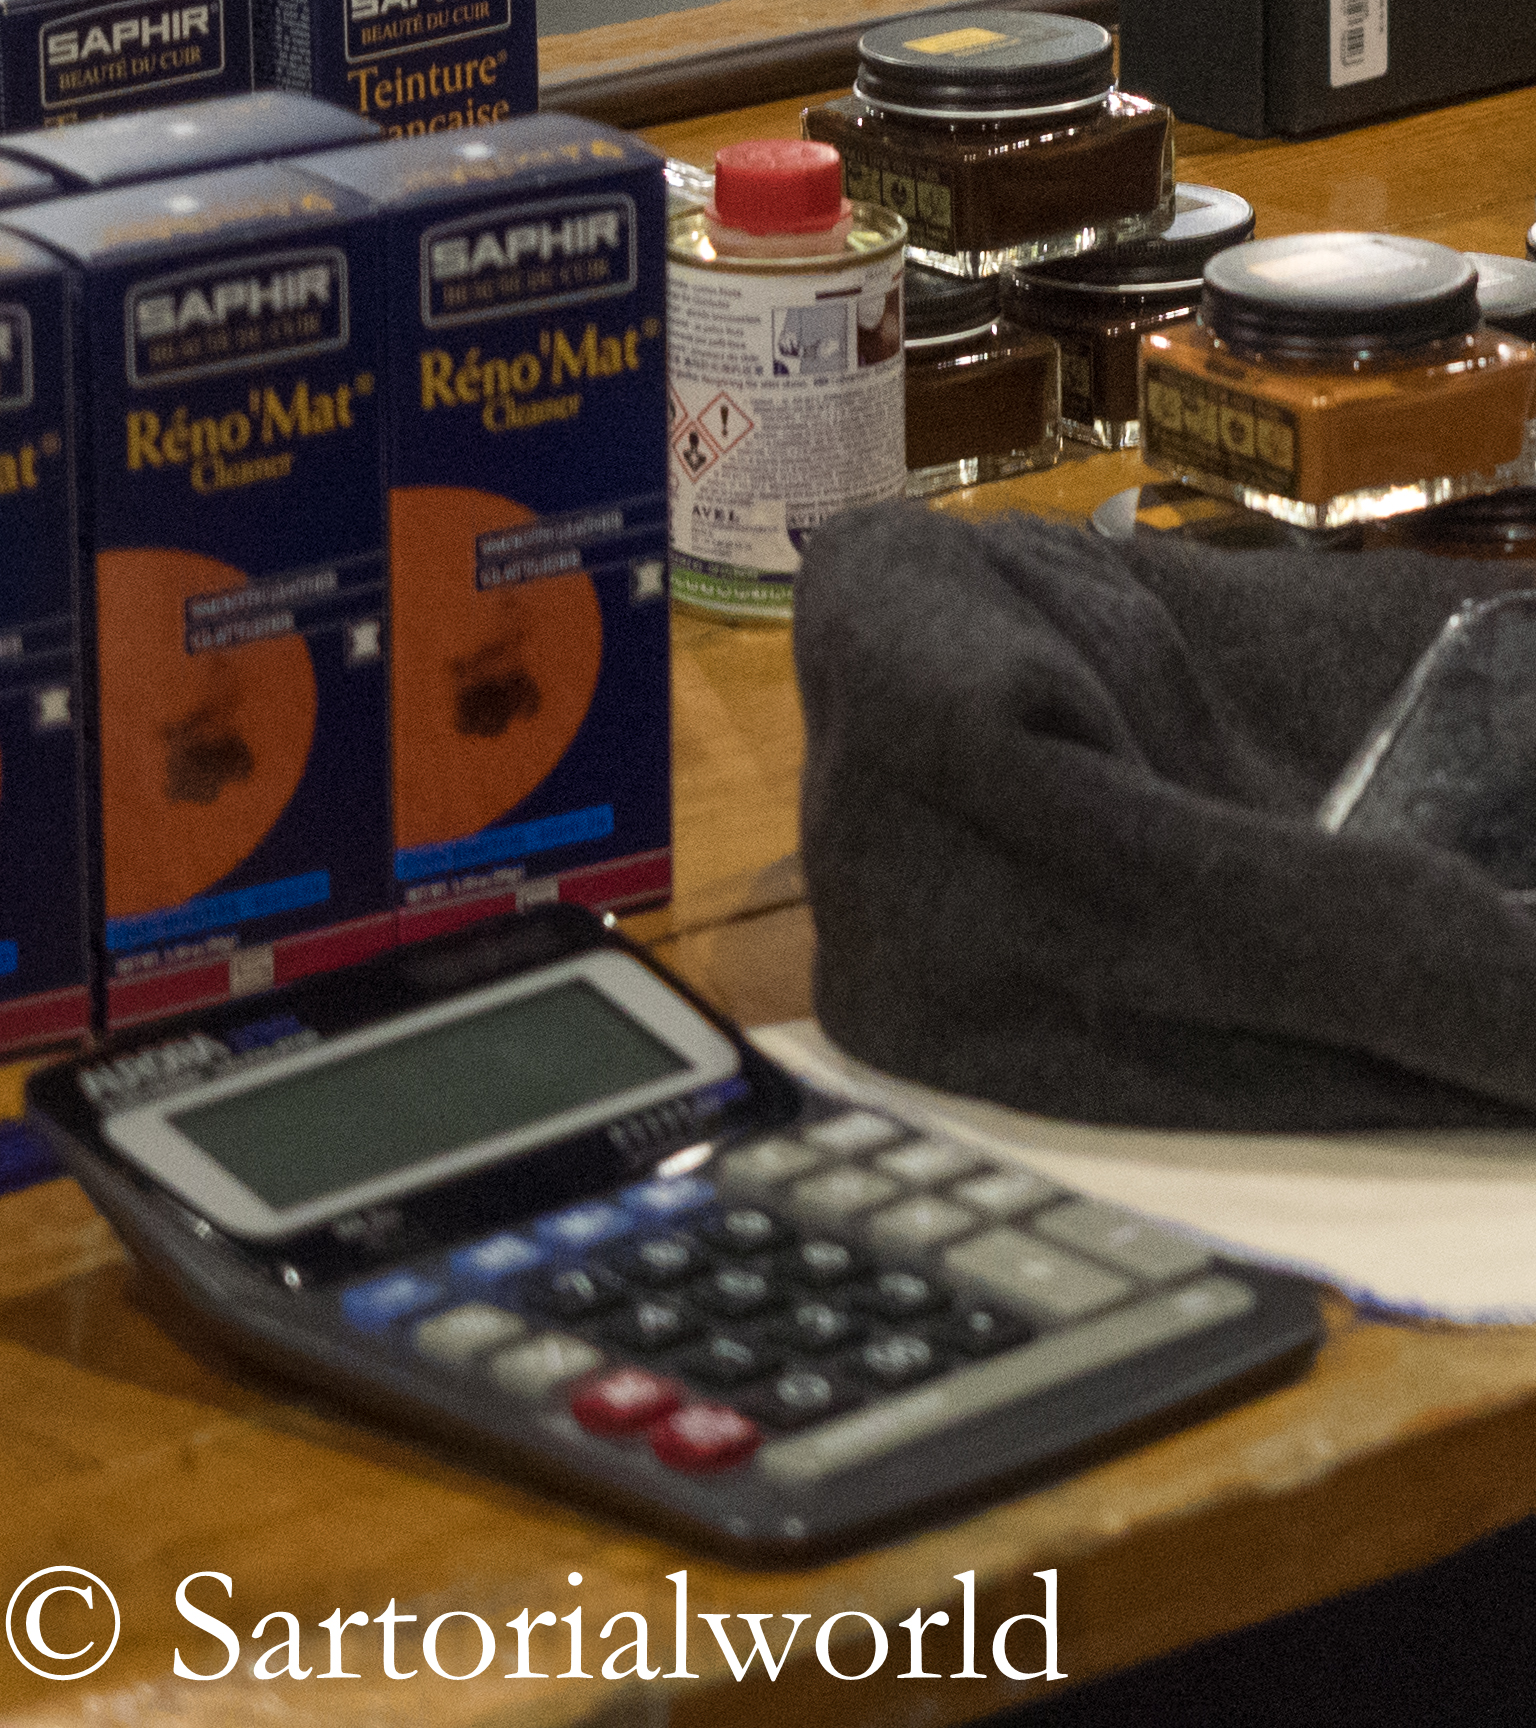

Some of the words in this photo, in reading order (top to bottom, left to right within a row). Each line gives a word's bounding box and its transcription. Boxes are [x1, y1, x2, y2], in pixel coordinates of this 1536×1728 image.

[47, 4, 210, 66] SAPHIR
[361, 14, 423, 45] BEAUTÉ
[427, 10, 450, 30] DU
[453, 2, 490, 27] CUIR
[59, 57, 128, 90] BEAUTÉ
[132, 55, 156, 76] DU
[160, 45, 202, 70] CUIR
[432, 210, 620, 281] SAPHIR
[138, 266, 331, 340] SAPHIR
